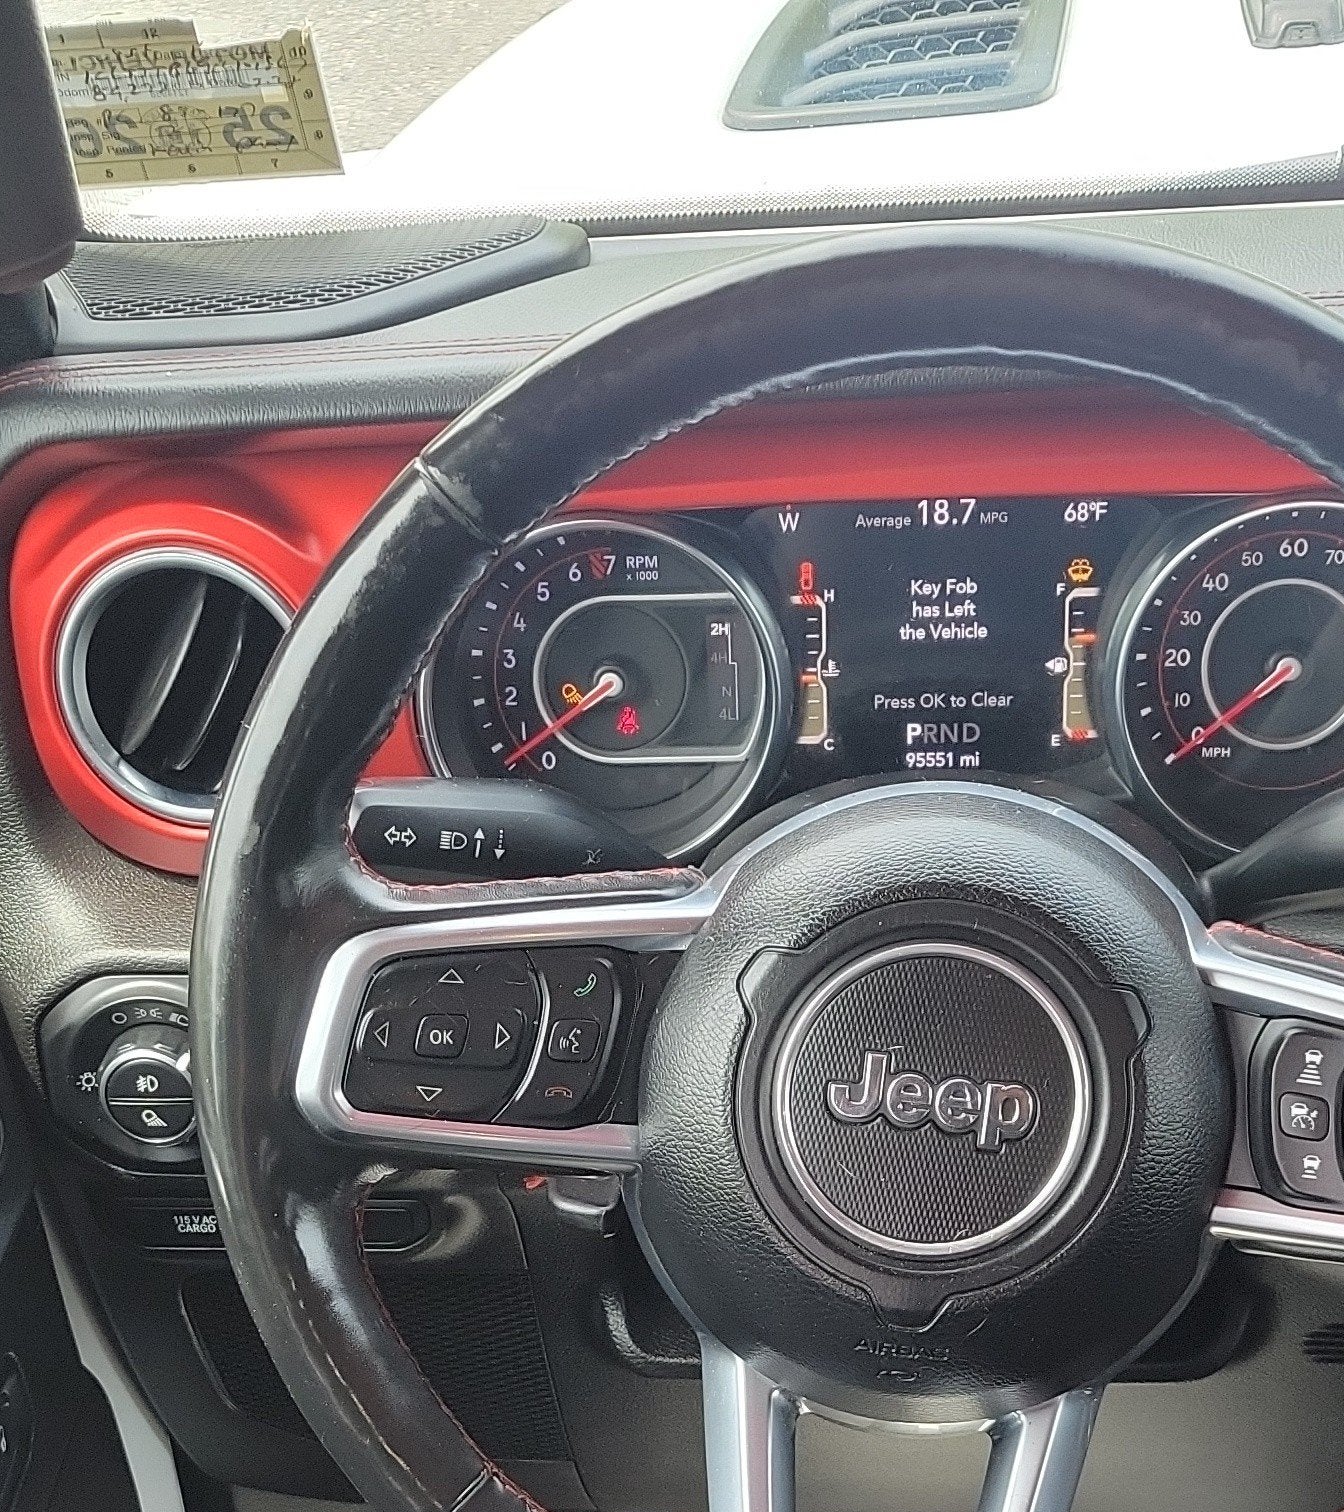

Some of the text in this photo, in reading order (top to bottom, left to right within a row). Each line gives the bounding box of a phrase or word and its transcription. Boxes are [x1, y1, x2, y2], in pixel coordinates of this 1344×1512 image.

[856, 499, 1009, 529] Average 18.7 MPG
[1063, 500, 1109, 522] 68°F
[778, 512, 800, 533] W
[1280, 538, 1309, 557] 60
[603, 555, 616, 575] 7
[626, 555, 658, 569] RPM
[1242, 552, 1263, 567] 50
[568, 563, 582, 582] 6
[635, 570, 659, 581] 1000
[911, 578, 978, 599] Key Fob
[1056, 583, 1066, 596] F
[1202, 573, 1229, 592] 40
[537, 582, 550, 601] 5
[824, 589, 835, 603] H
[912, 601, 976, 618] has Left
[1180, 610, 1201, 626] 30
[513, 612, 526, 632] 4
[710, 623, 729, 636] 2H
[900, 622, 988, 640] the Vehicle
[503, 649, 516, 668] 3
[710, 652, 728, 665] 4H
[1165, 649, 1191, 667] 20
[505, 686, 518, 706] 2
[722, 686, 732, 698] N
[1175, 692, 1190, 707] 10
[874, 692, 1013, 710] Press OK to Clear
[718, 708, 735, 721] 4L
[824, 738, 835, 751] C
[1051, 735, 1061, 748] E
[541, 750, 556, 770] 0
[905, 751, 981, 769] 95551 mi
[1201, 746, 1231, 759] MPH
[429, 1029, 454, 1046] OK
[827, 1050, 1039, 1153] Jeep
[172, 1215, 217, 1224] 115 AC
[177, 1223, 216, 1233] CARGO
